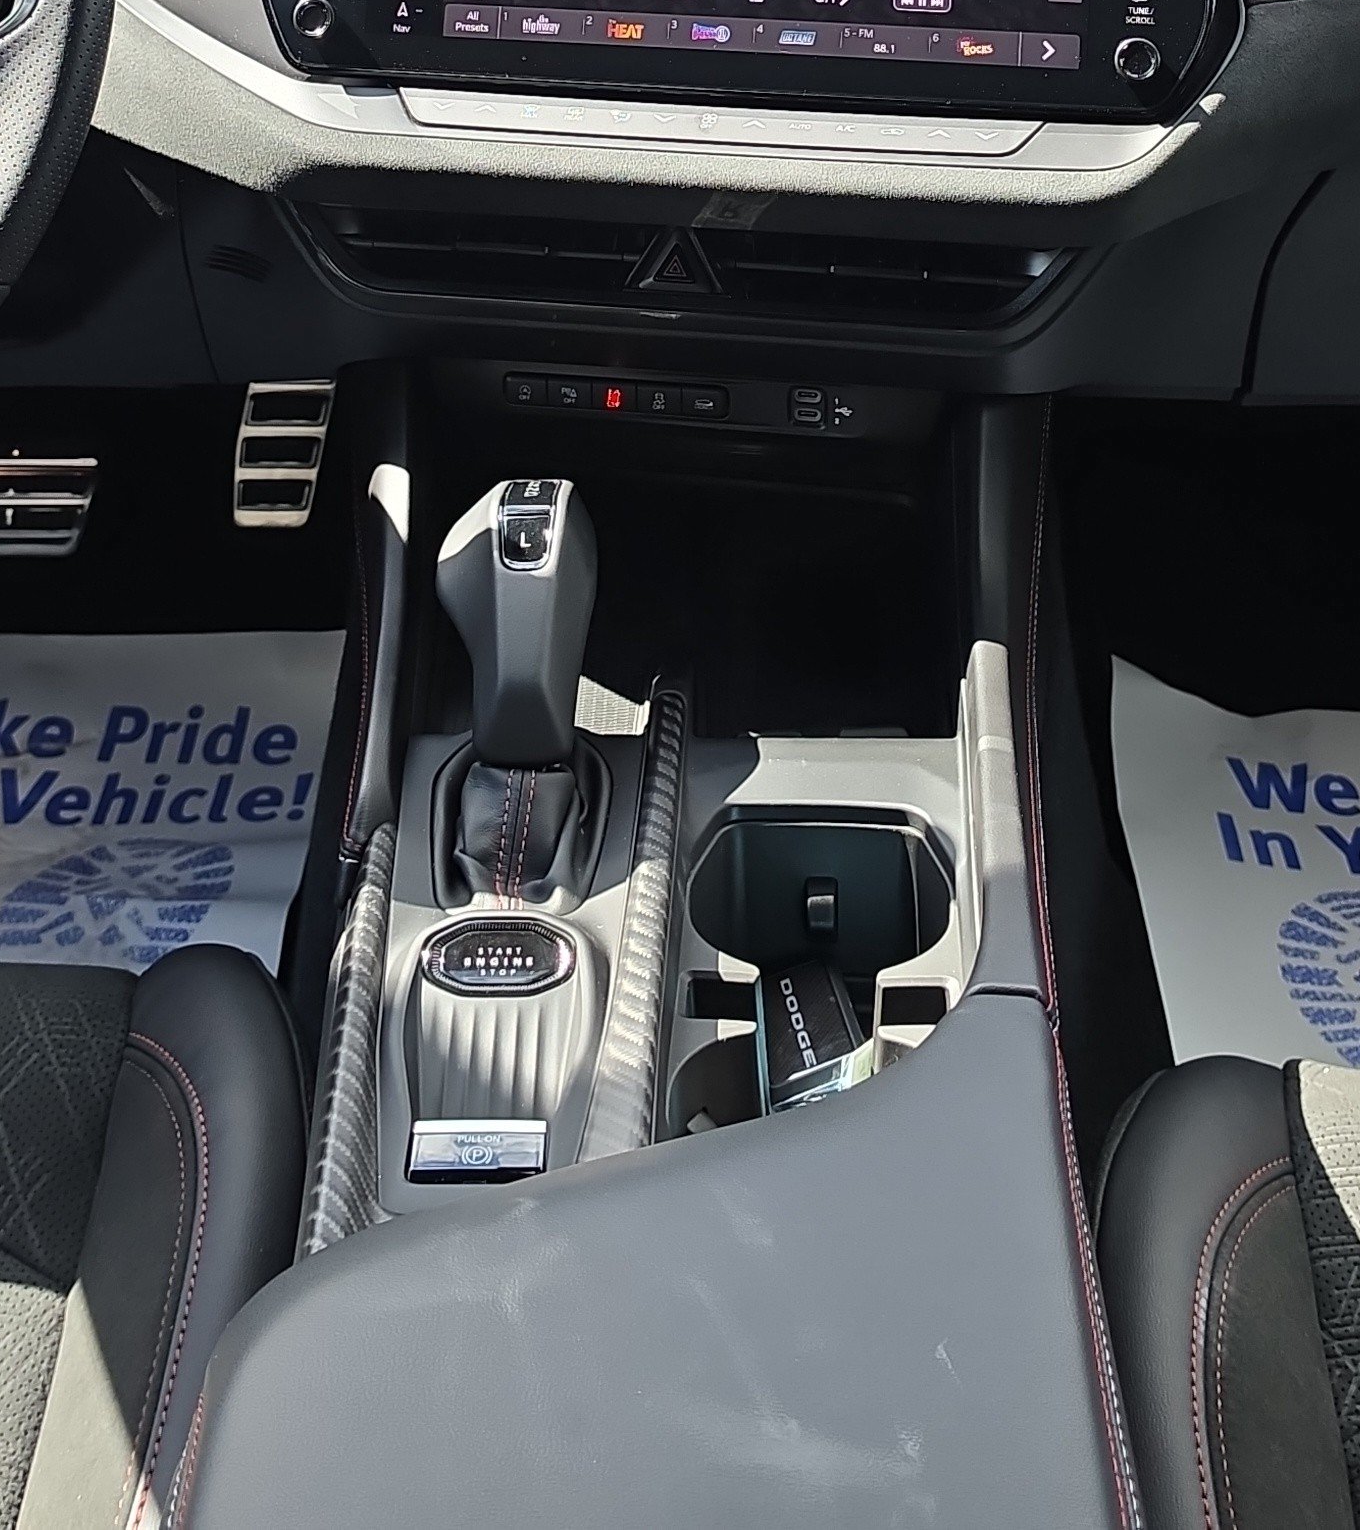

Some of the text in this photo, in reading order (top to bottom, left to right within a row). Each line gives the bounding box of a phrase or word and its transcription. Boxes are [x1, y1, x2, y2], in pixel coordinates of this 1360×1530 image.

[466, 11, 479, 20] All
[1128, 6, 1154, 16] TUNE/
[503, 12, 508, 21] 1
[586, 16, 593, 25] 2
[1125, 16, 1155, 25] SCROLL
[393, 24, 411, 33] Nav
[455, 22, 489, 34] Presets
[522, 19, 561, 35] highway
[671, 20, 678, 29] 3
[757, 24, 764, 33] 4
[607, 23, 644, 39] HEAT
[844, 28, 850, 38] 5
[859, 29, 874, 39] FM
[933, 33, 939, 43] 6
[873, 43, 895, 54] 88.1
[963, 44, 994, 57] ROCKS
[789, 123, 812, 131] AUTO
[835, 124, 855, 133] A/C
[520, 531, 532, 549] L
[96, 705, 298, 765] Pride
[1226, 755, 1360, 817] We
[1216, 811, 1302, 872] In
[478, 947, 521, 956] START
[463, 956, 534, 967] ENGINE
[779, 977, 818, 1069] DODGE
[457, 1134, 501, 1143] PULL-ON
